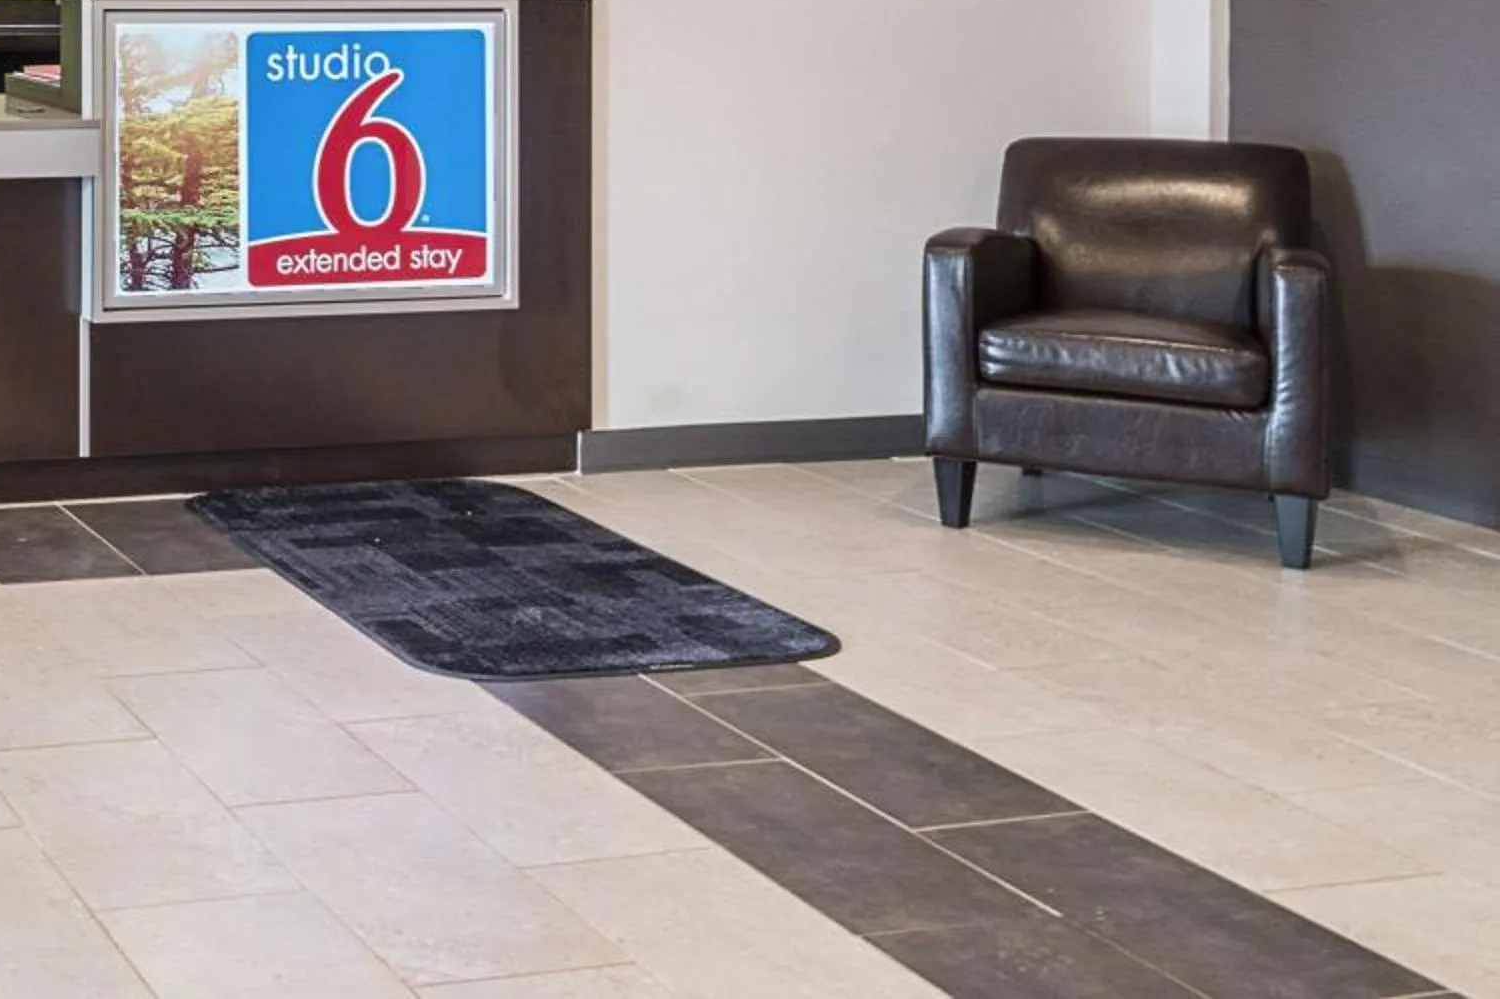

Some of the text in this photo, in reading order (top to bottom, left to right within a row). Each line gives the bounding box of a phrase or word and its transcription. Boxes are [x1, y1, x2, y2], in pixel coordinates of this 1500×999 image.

[266, 43, 391, 83] studio
[313, 68, 427, 233] 6
[276, 244, 464, 276] extended stay
